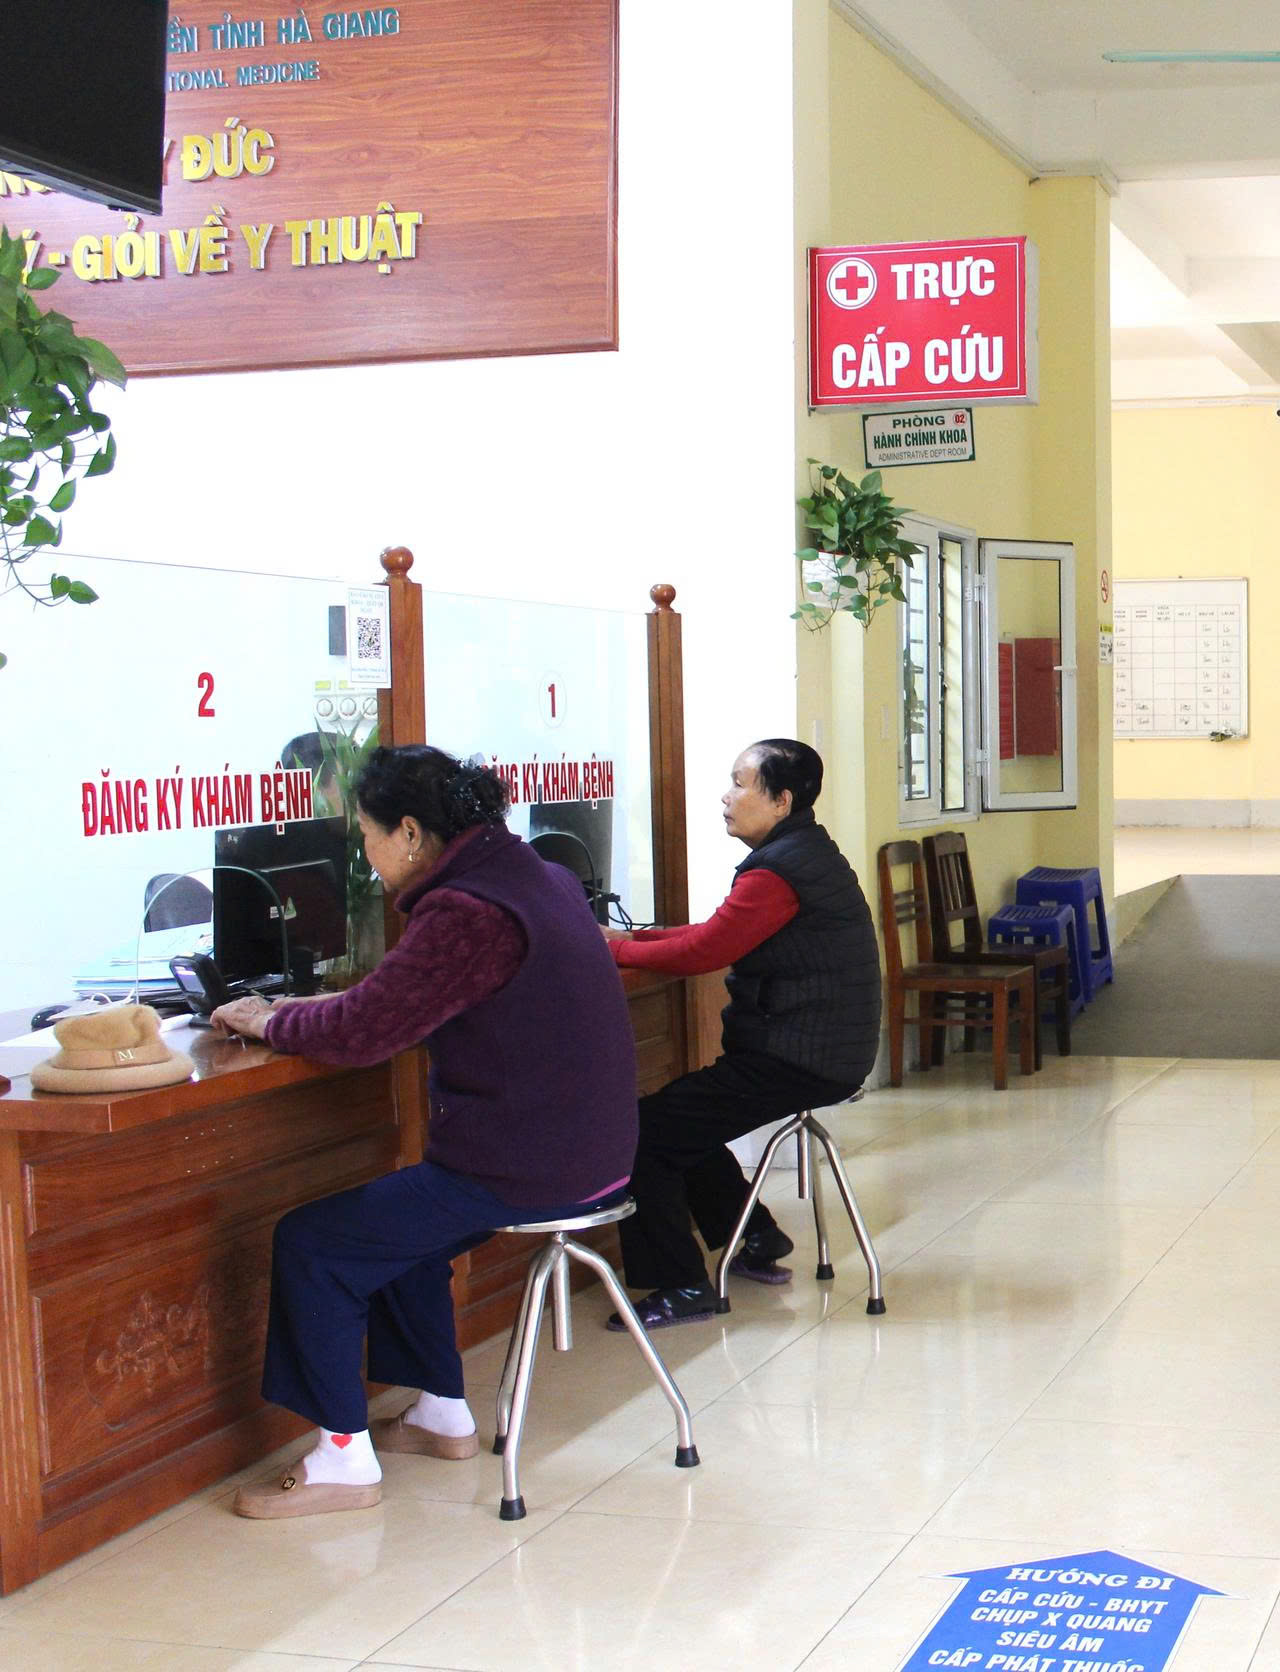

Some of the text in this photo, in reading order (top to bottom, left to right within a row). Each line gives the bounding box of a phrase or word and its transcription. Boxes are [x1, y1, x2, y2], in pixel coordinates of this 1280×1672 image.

[208, 12, 265, 50] TỈNH
[277, 8, 313, 44] HÀ
[322, 8, 400, 41] GIANG
[236, 61, 320, 86] MEDICINE
[181, 117, 275, 181] ĐỨC
[72, 213, 161, 281] GIỎI
[168, 204, 229, 274] VỀ
[240, 223, 274, 270] Y
[285, 202, 423, 274] THUẬT
[890, 256, 995, 305] TRỰC
[832, 325, 1004, 389] CẤP CỨU
[892, 414, 965, 428] PHÒNG 02
[873, 429, 967, 449] HÀNH CHÍNH KHOA
[878, 447, 967, 461] ADMINISTRATIVE DEPT ROOM
[197, 672, 215, 718] 2
[548, 683, 556, 718] 1
[522, 754, 538, 803] KÝ
[543, 753, 579, 802] KHÁM
[583, 753, 614, 807] BỆNH
[81, 761, 313, 837] ĐĂNG KÝ KHÁM BỆNH
[1005, 1567, 1176, 1590] HƯỚNG ĐI
[978, 1586, 1029, 1604] CẤP
[1033, 1591, 1085, 1609] CỨU
[1104, 1598, 1168, 1615] BHYT
[970, 1607, 1153, 1633] CHỤP X QUANG
[996, 1630, 1105, 1652] SIÊU ÂM
[928, 1647, 1144, 1672] CẤP PHÁT THUỐC
